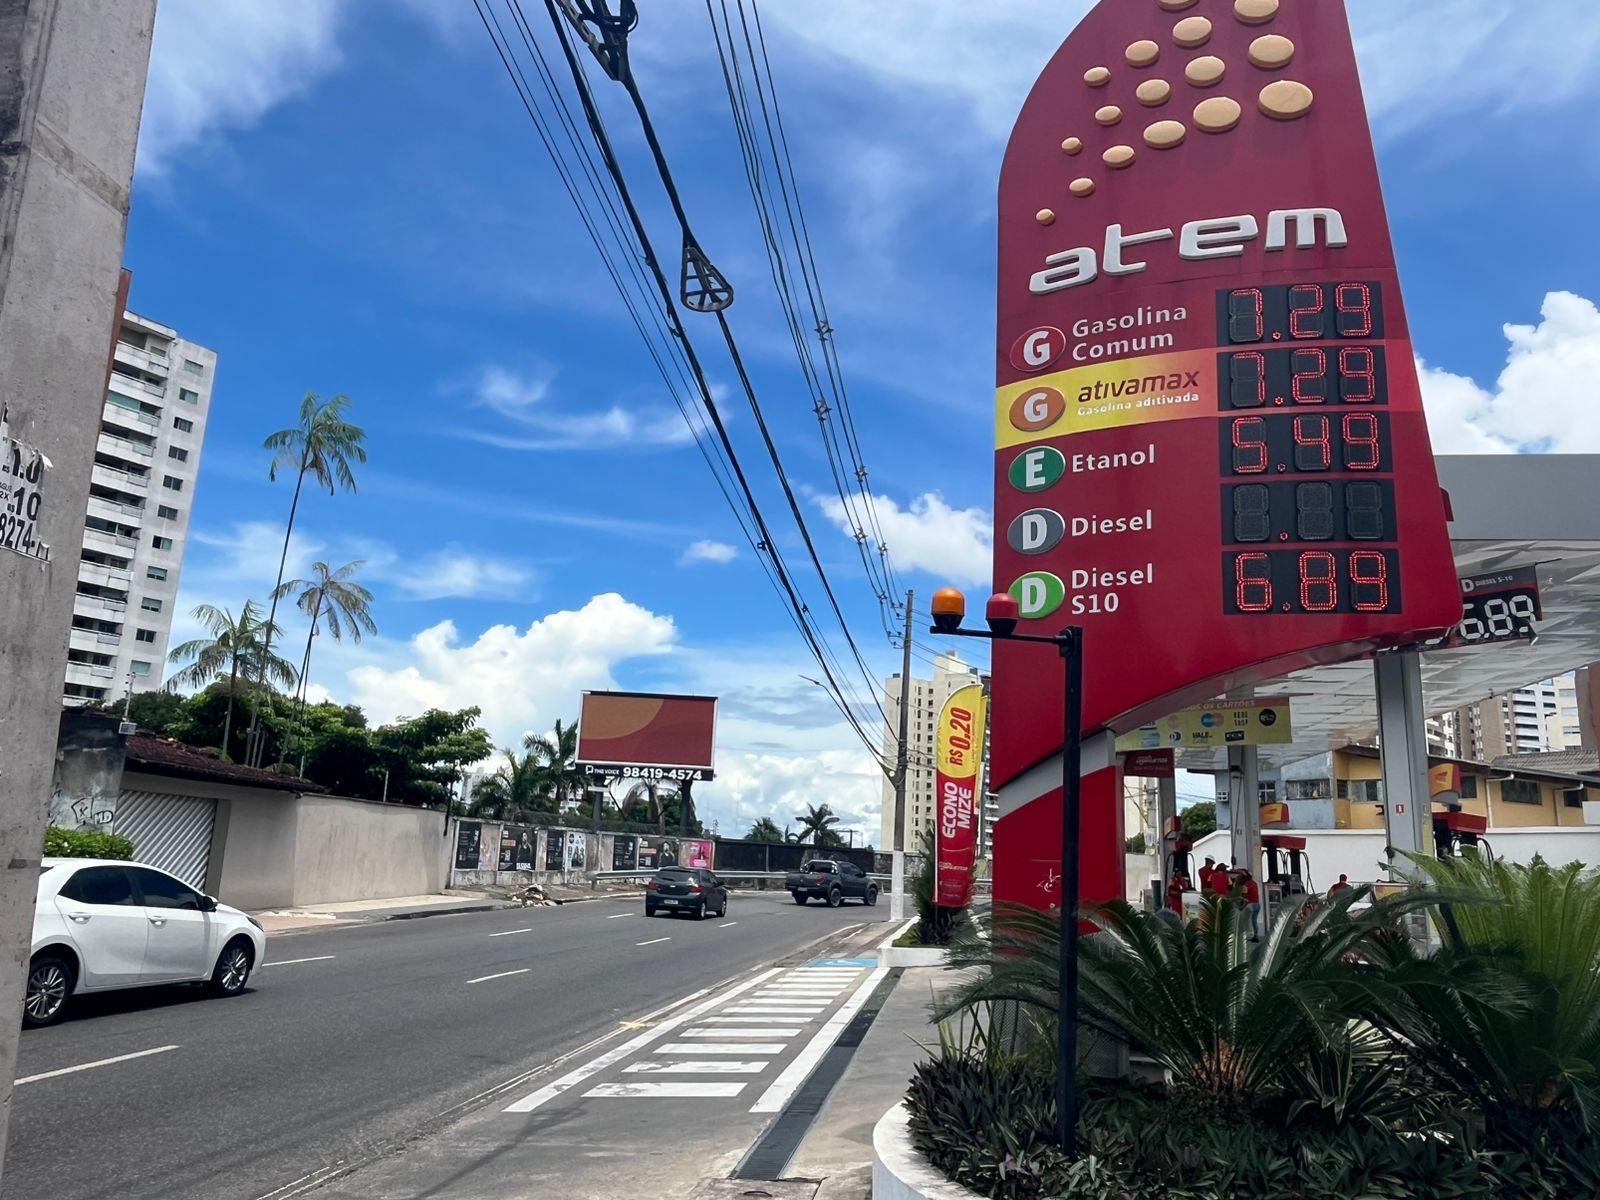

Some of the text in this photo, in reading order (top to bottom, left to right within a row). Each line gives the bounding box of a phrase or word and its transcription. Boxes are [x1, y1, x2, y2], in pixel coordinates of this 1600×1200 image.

[1029, 207, 1348, 294] atem
[1072, 304, 1187, 337] Gasolina
[1023, 330, 1050, 368] G
[1072, 331, 1174, 361] Comum
[1078, 370, 1200, 403] ativamax
[1023, 392, 1048, 422] G
[1077, 392, 1200, 416] Gasolina aditivada
[1072, 444, 1155, 473] Etanol
[1232, 412, 1380, 473] 5.49
[1025, 450, 1046, 488] E
[1022, 515, 1048, 550] D
[1071, 509, 1153, 537] Diesel
[1071, 563, 1153, 589] Diesel
[1236, 550, 1388, 612] 6.89
[1021, 577, 1047, 614] D
[1071, 592, 1119, 615] S10
[623, 766, 702, 780] 98419-4574
[942, 782, 958, 839] ECONO
[956, 787, 972, 830] MIZE
